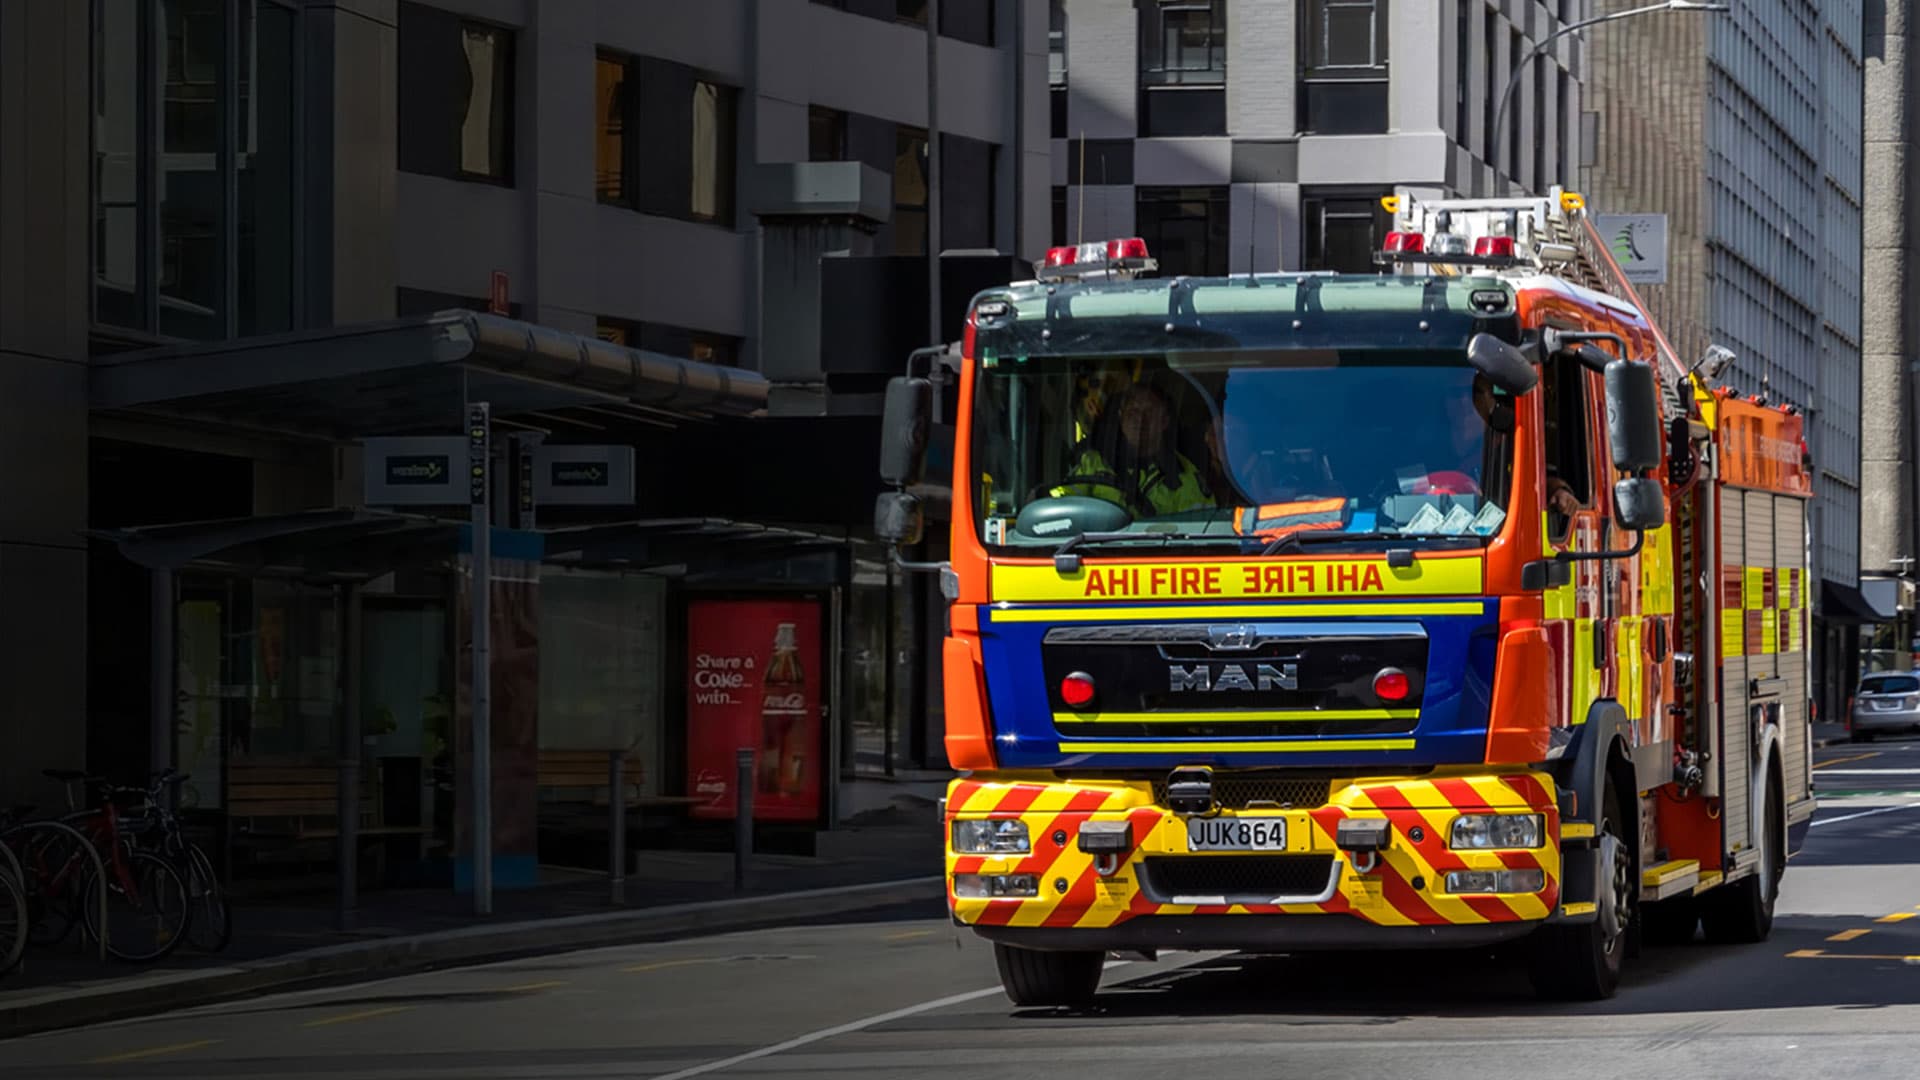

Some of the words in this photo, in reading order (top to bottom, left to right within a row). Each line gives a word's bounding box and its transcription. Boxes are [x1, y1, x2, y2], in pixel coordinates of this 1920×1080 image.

[1084, 568, 1139, 597] AHI
[1151, 566, 1222, 595] FIRE
[696, 654, 741, 669] Share
[744, 656, 755, 669] a
[1169, 663, 1299, 693] MAN
